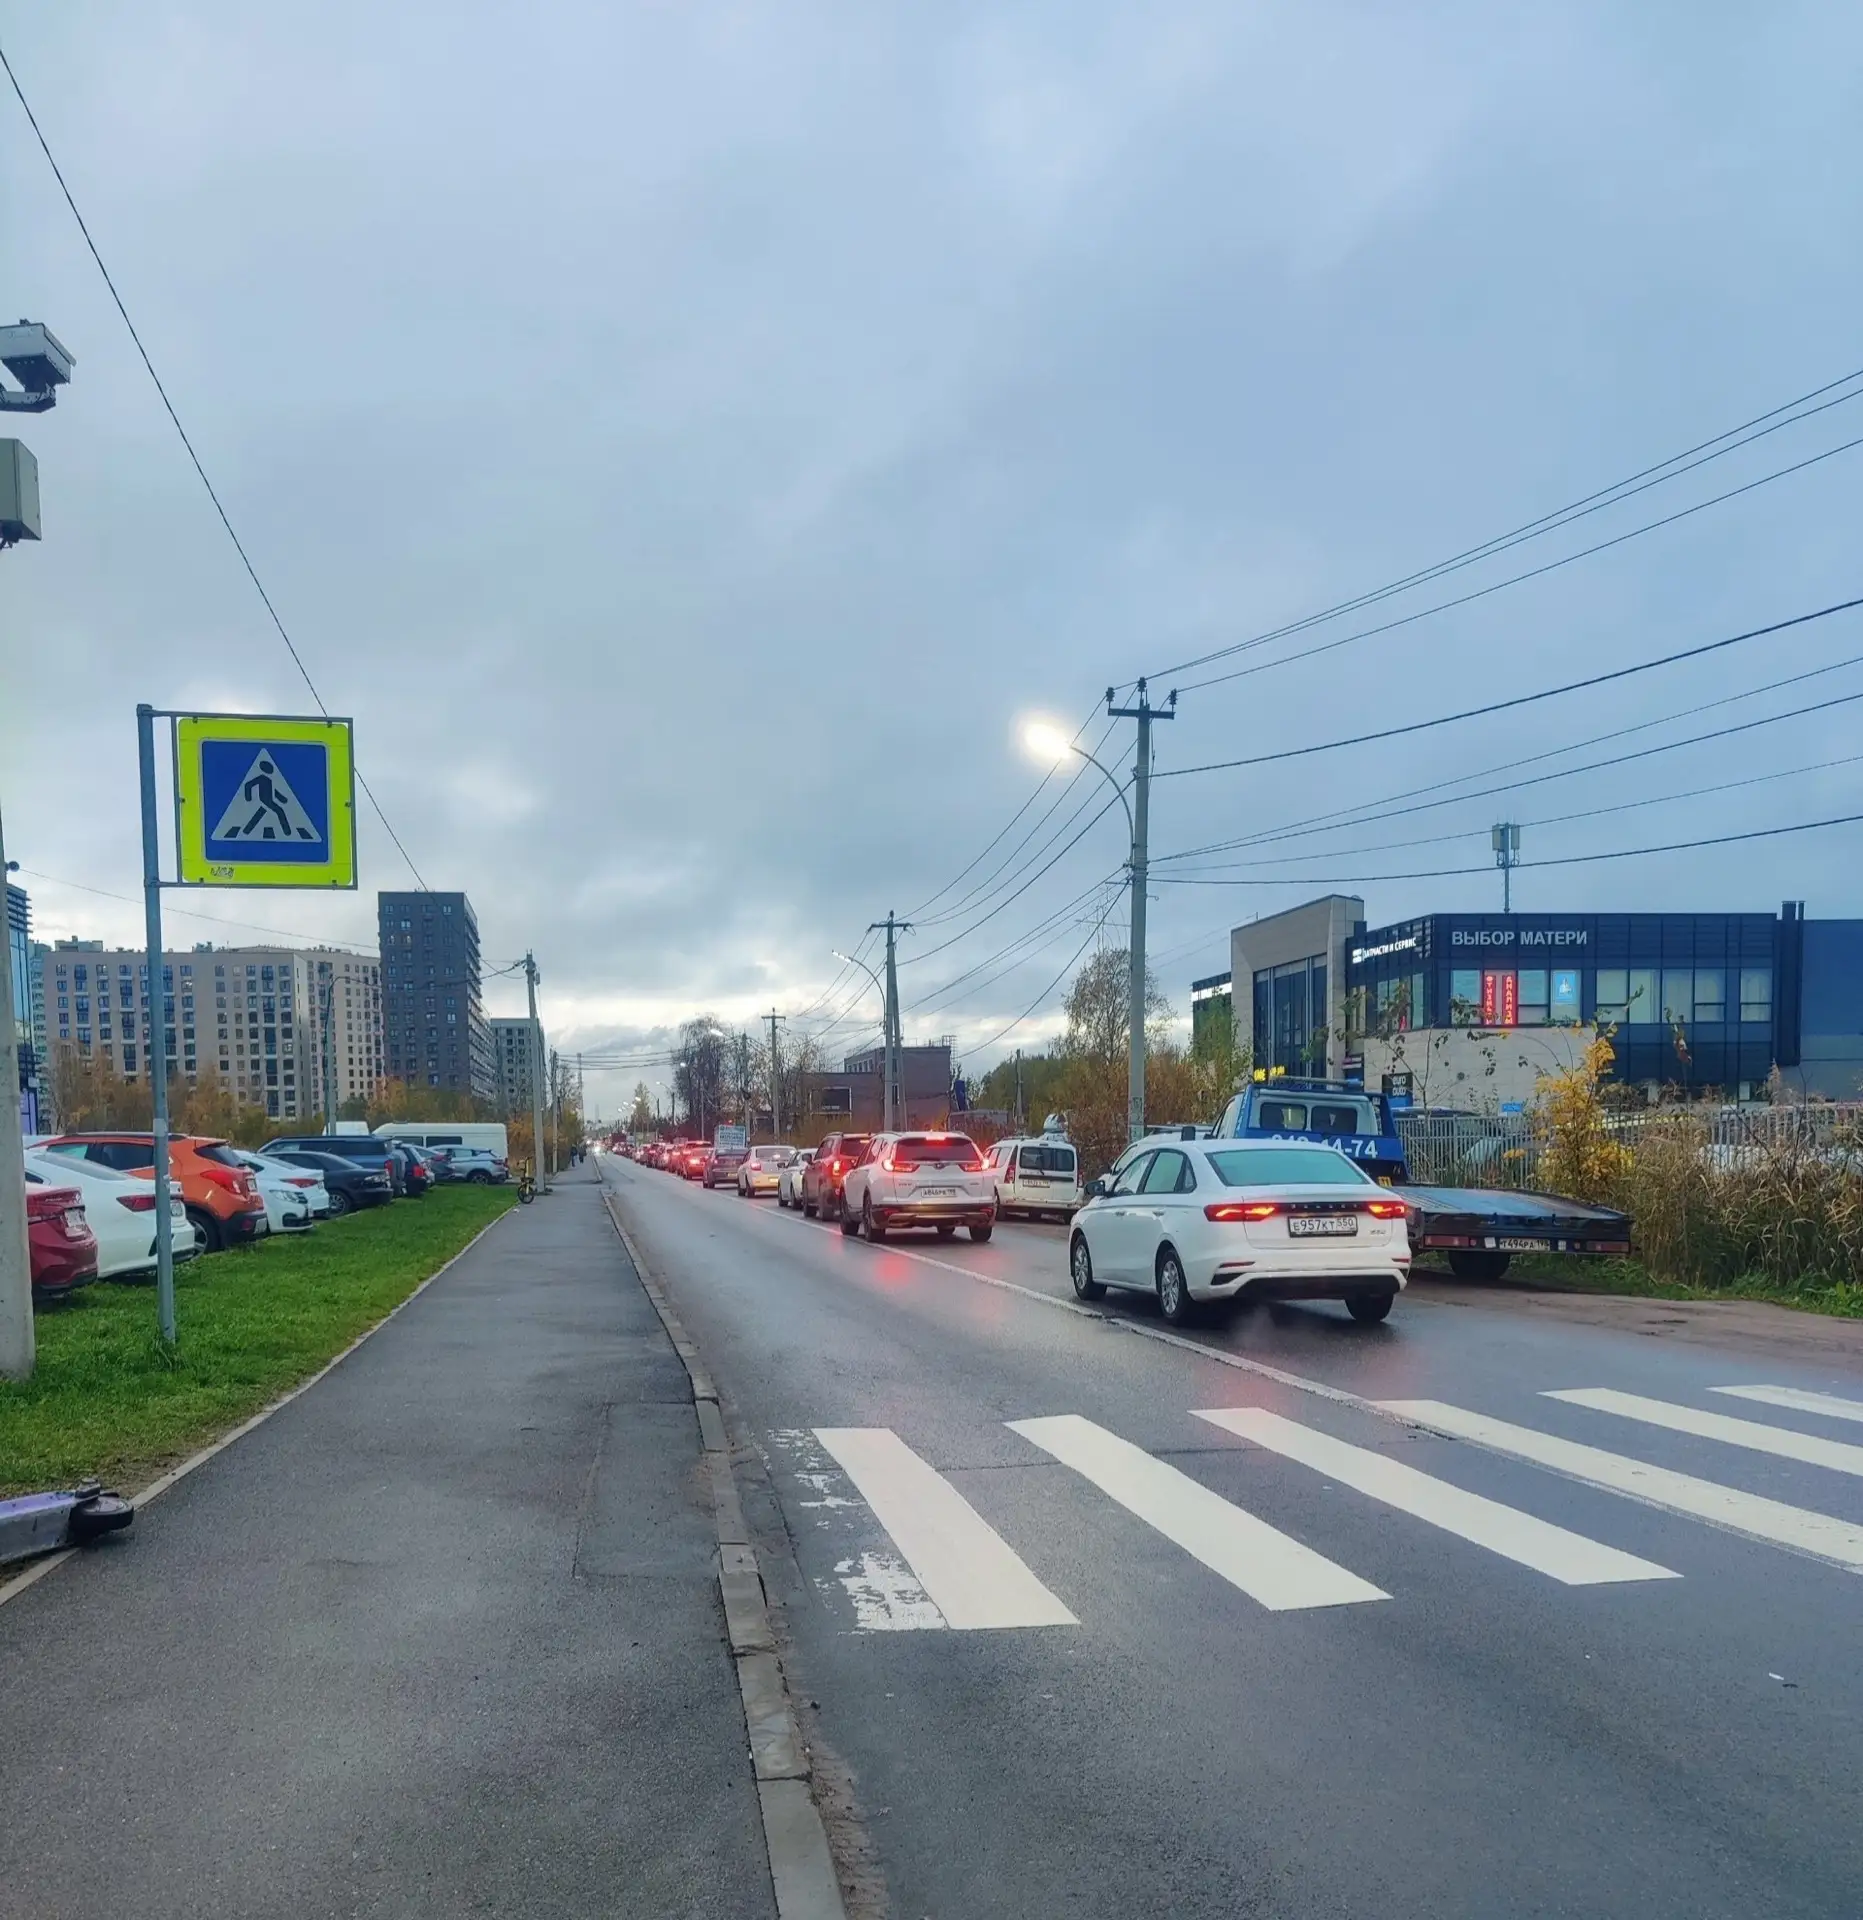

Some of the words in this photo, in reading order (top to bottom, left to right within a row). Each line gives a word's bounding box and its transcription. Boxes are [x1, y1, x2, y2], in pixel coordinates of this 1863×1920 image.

[1451, 930, 1515, 946] ВЫБОР
[1520, 930, 1588, 946] МАТЕРИ
[1363, 944, 1389, 959] ЗАПЧАСТИ
[1394, 937, 1417, 951] СЕРВИС
[1293, 1219, 1335, 1231] Е957КТ
[1336, 1218, 1354, 1227] 550
